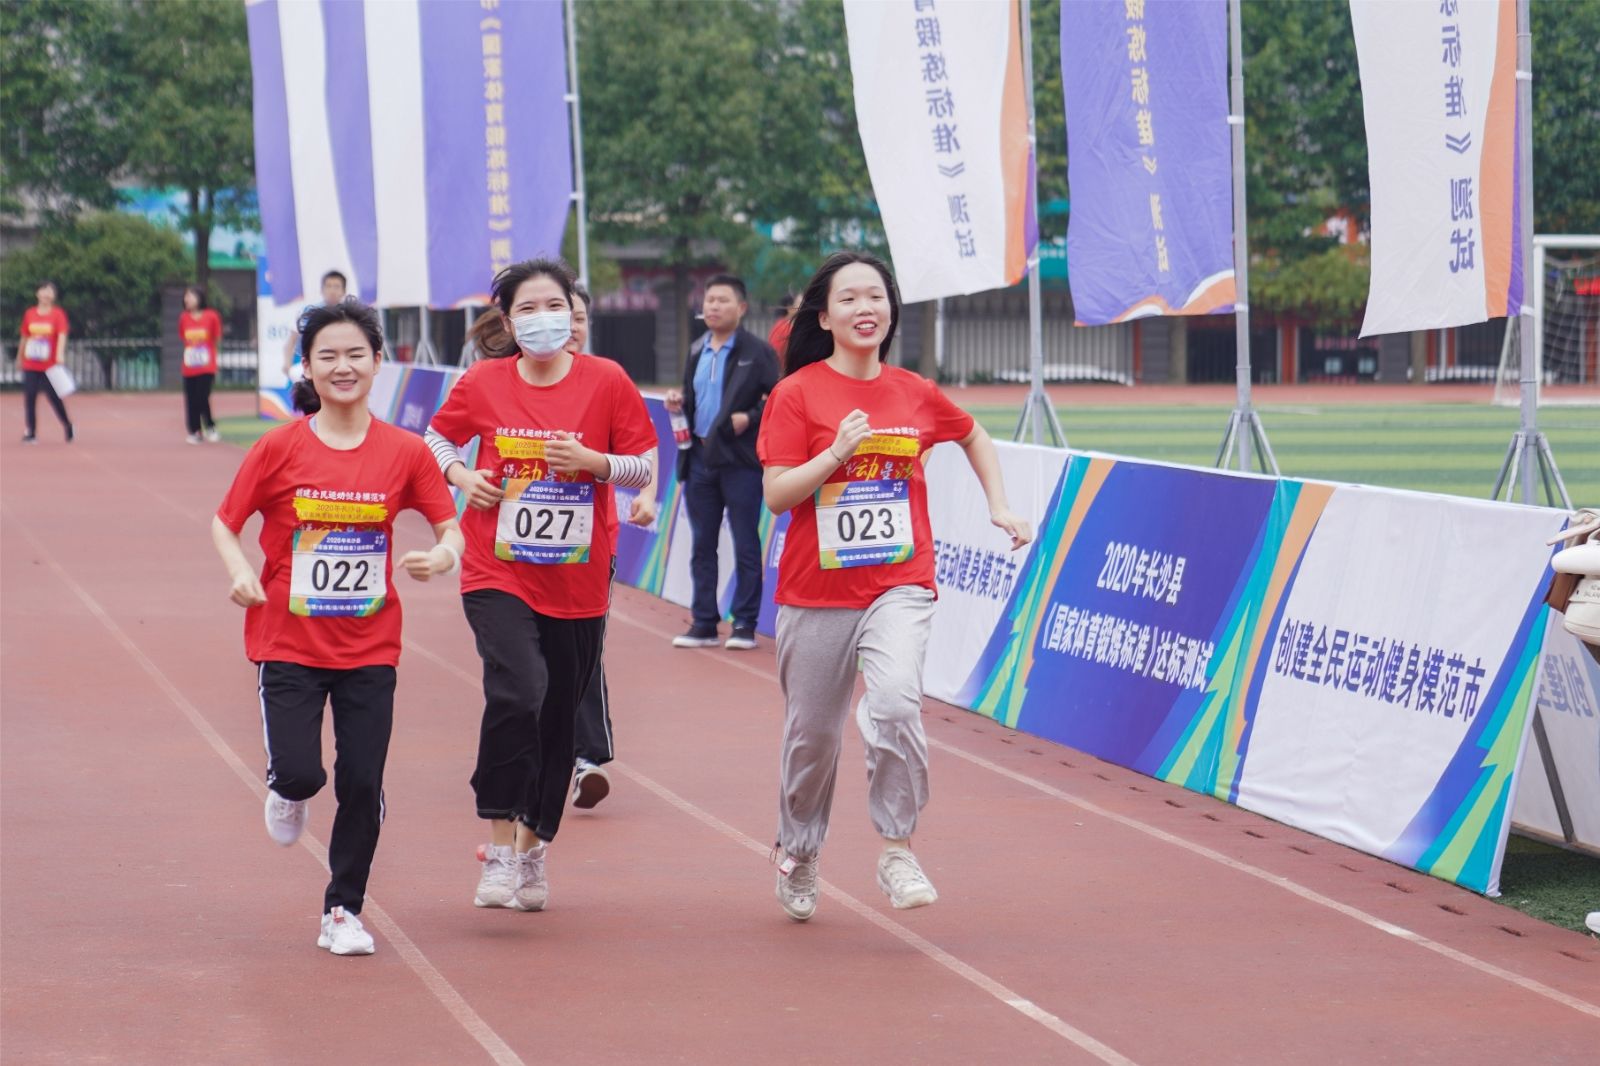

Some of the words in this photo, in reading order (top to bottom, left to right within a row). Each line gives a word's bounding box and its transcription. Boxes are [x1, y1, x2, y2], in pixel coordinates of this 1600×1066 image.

[515, 507, 575, 541] 027
[837, 508, 895, 543] 023
[312, 559, 369, 592] 022
[1096, 541, 1187, 606] 2020年长沙县
[1041, 602, 1215, 693] 《国家体育锻炼标准》达标测试
[1275, 618, 1486, 722] 创建全民运动健身模范市
